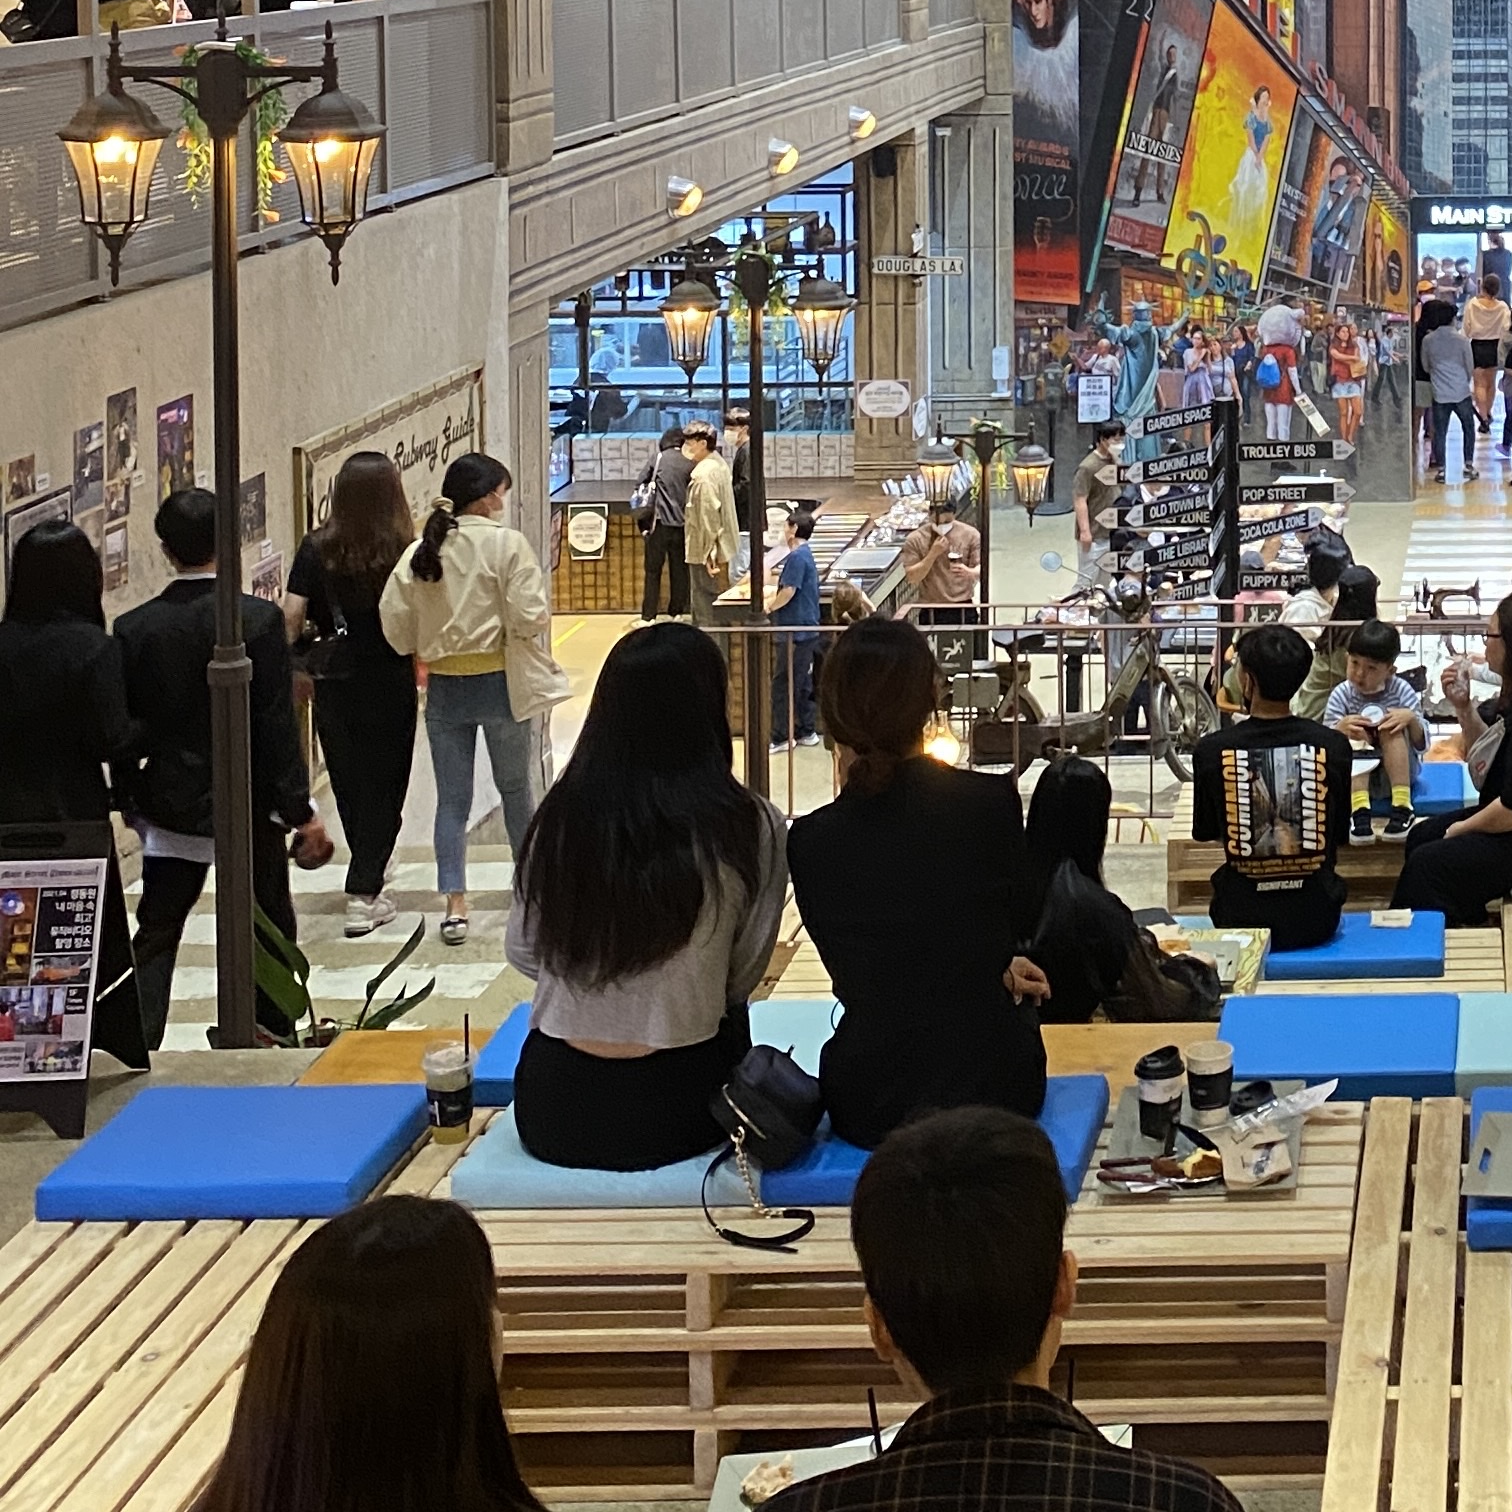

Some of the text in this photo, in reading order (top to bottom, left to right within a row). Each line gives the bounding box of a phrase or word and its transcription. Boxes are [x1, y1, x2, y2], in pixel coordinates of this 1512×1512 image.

[1430, 205, 1485, 225] MAIN
[877, 260, 936, 272] DOUGLAS
[1147, 406, 1212, 431] GARDEN SPACE
[1242, 444, 1316, 458] TROLLEY BUS
[1148, 456, 1188, 476] SMOKING
[1242, 487, 1307, 501] POP STREET
[1149, 505, 1167, 519] OLD
[1168, 499, 1194, 514] TOWN
[1262, 519, 1285, 534] COLA
[1285, 513, 1307, 529] ZONE
[1157, 537, 1209, 562] THE LIBRAR
[1242, 574, 1279, 587] PUPPY
[1280, 574, 1289, 587] &
[1300, 743, 1329, 851] UNIQUE
